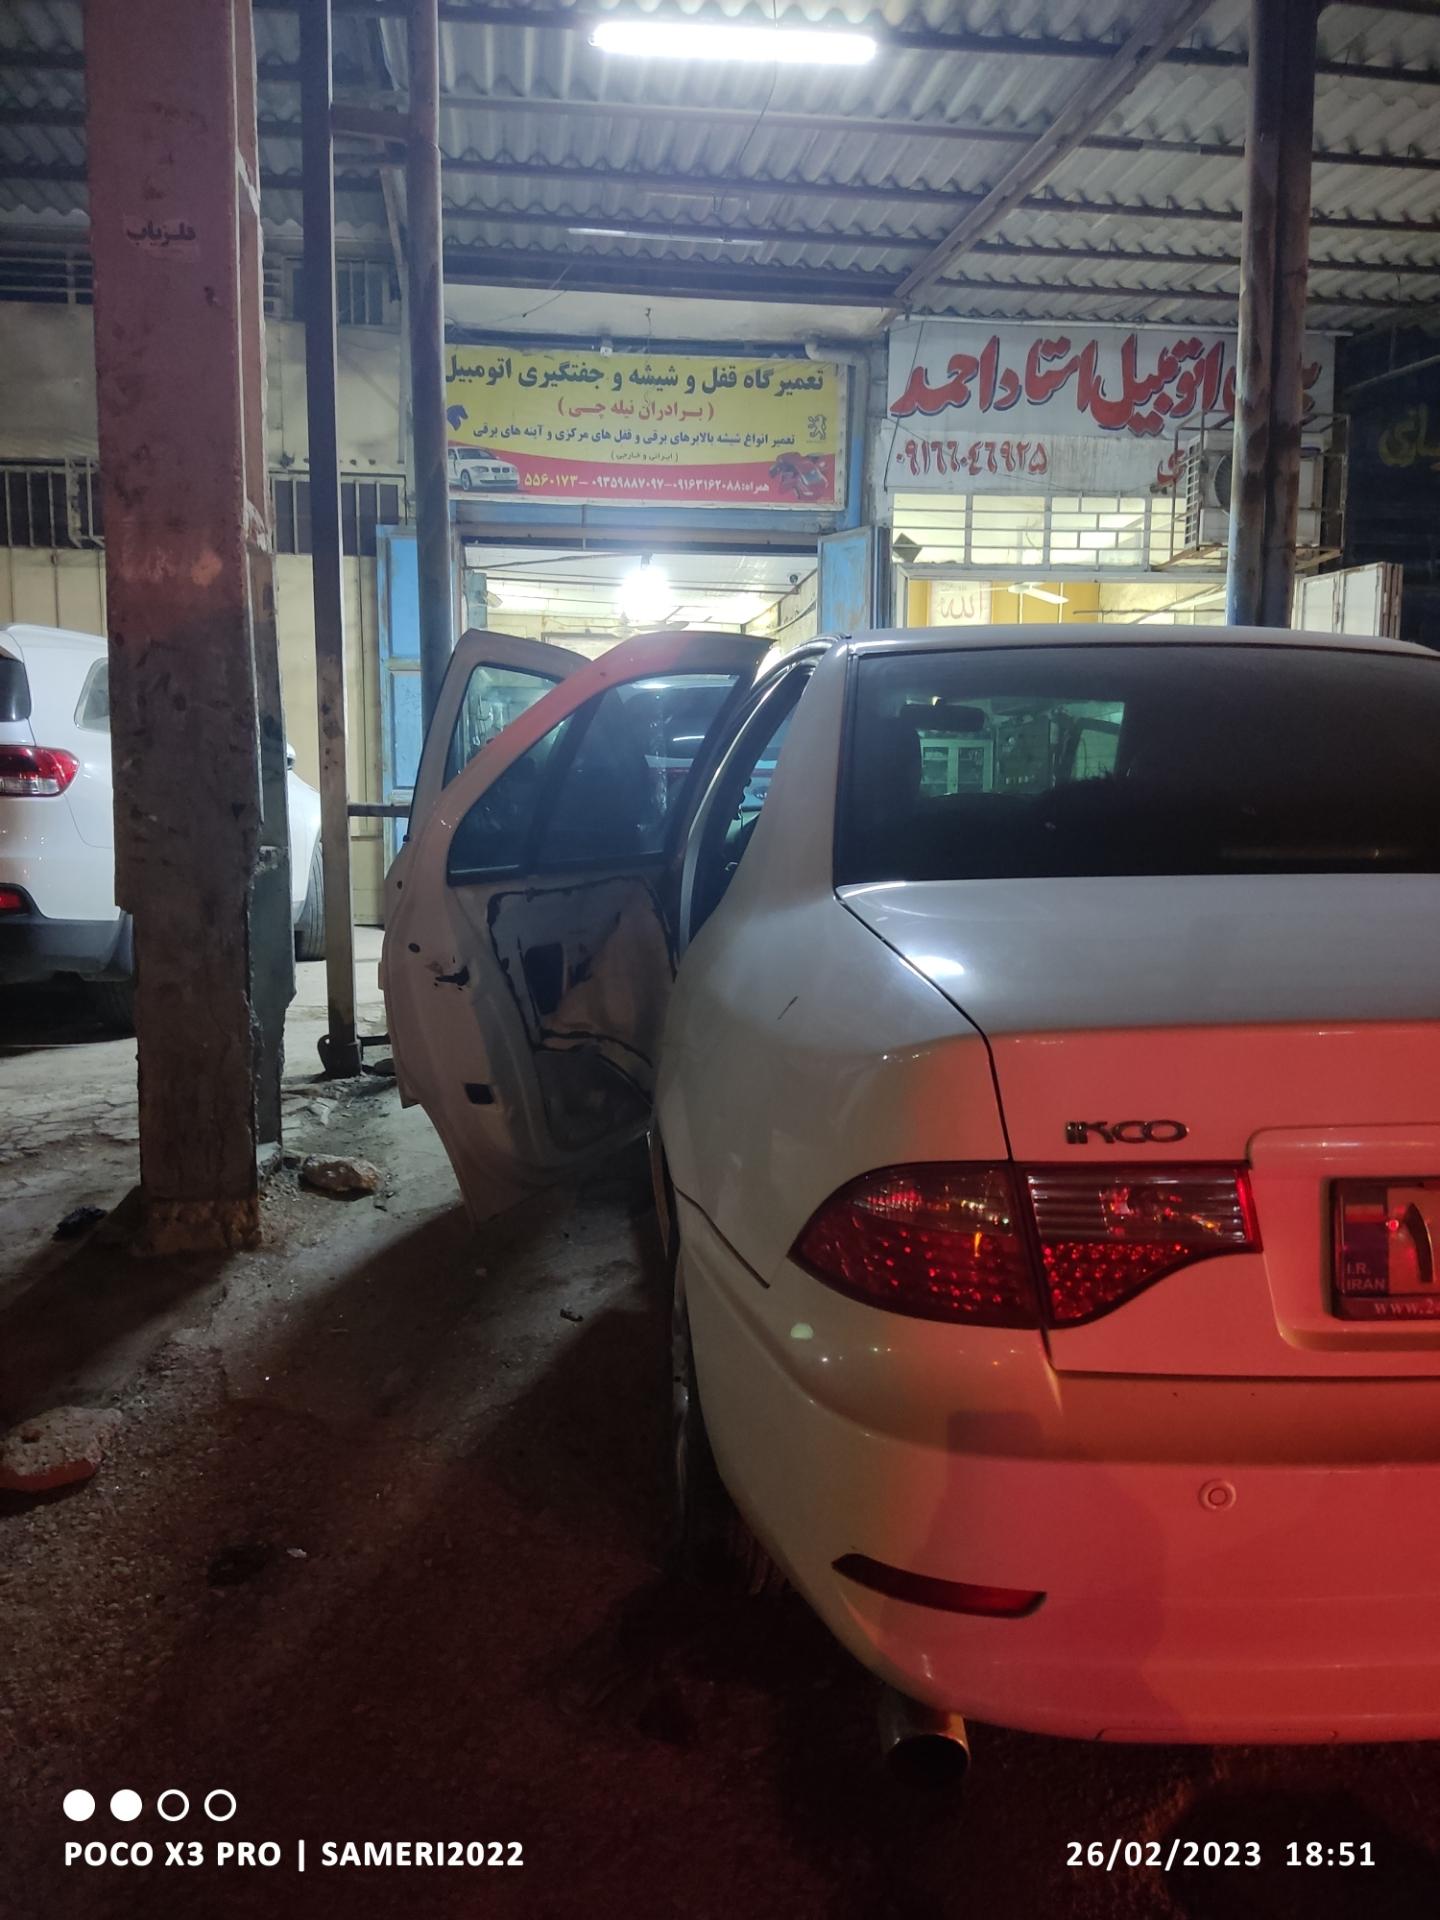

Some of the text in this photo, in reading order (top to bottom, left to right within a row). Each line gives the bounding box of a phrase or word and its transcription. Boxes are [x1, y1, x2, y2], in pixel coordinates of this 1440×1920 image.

[517, 360, 605, 390] جفتگیری
[611, 371, 623, 392] و
[628, 364, 679, 392] شیشه
[701, 365, 738, 395] قفل
[684, 374, 697, 394] و
[473, 423, 498, 439] برقی
[555, 427, 589, 443] مرکزی
[591, 429, 611, 443] های
[614, 429, 633, 444] قفل
[643, 429, 667, 446] برقی
[716, 432, 741, 445] شیشه
[771, 434, 796, 448] تعمیر
[1065, 1119, 1190, 1145] IKCO
[1346, 1279, 1386, 1291] IRAN
